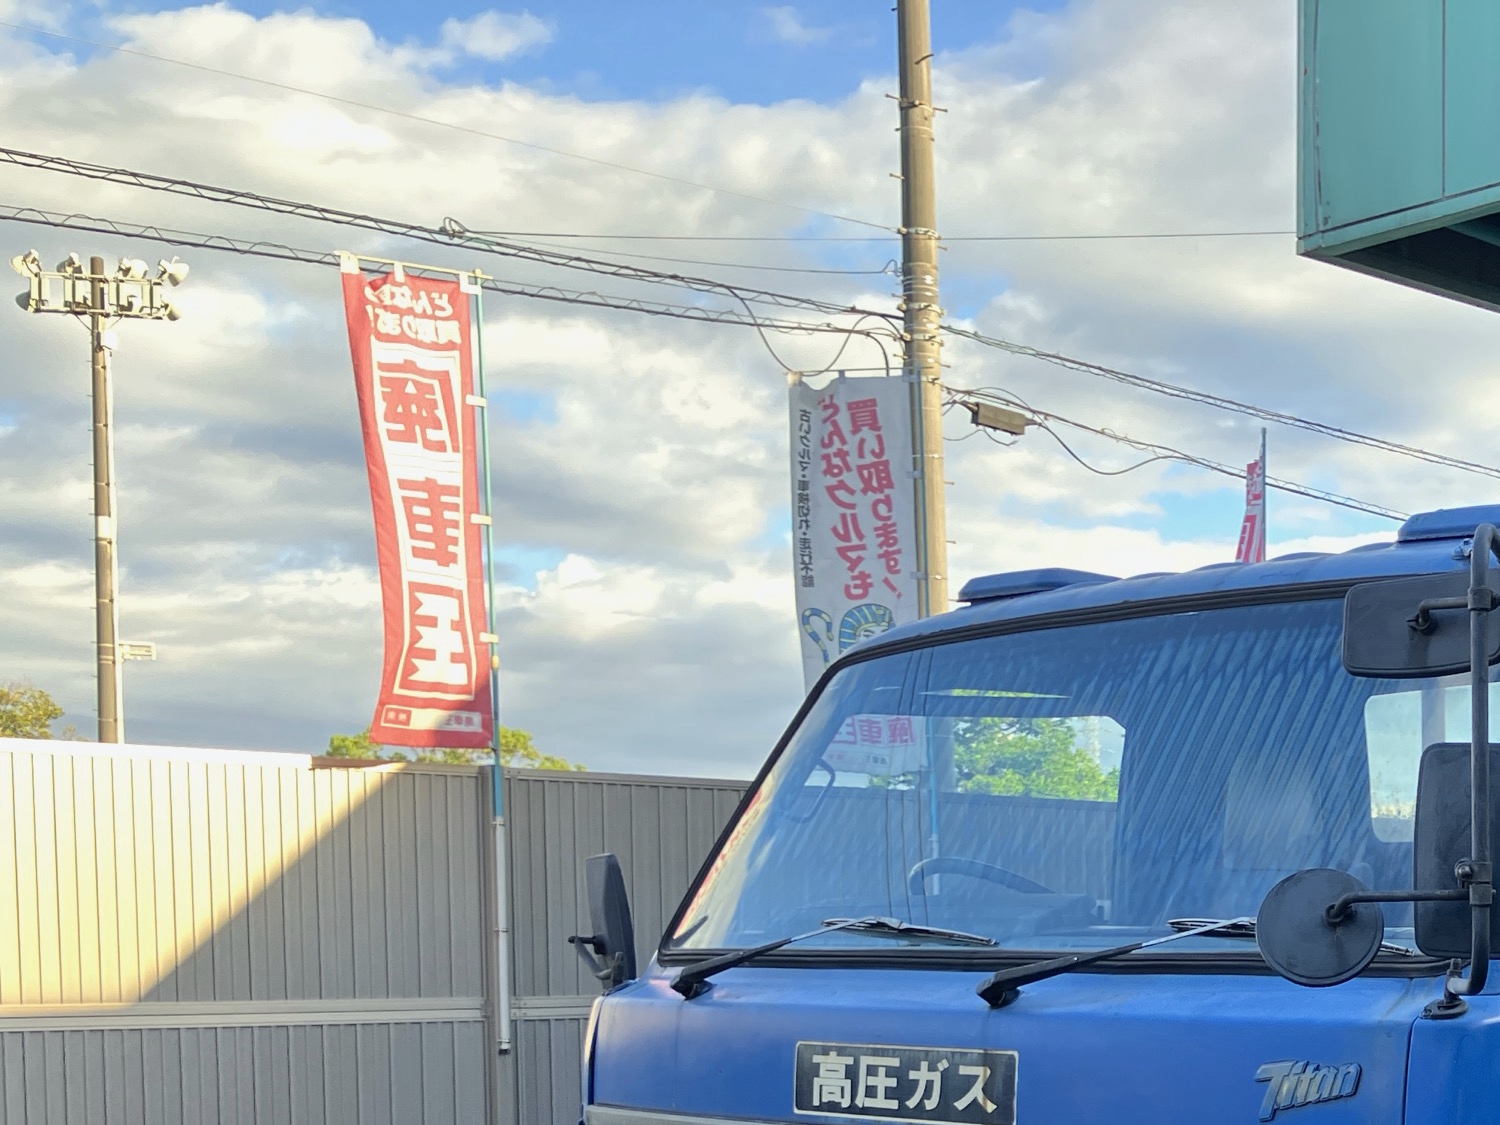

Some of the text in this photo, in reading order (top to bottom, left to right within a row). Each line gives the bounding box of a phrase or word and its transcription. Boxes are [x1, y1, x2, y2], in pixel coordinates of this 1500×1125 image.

[811, 1051, 998, 1114] 高圧ガス
[1255, 1059, 1362, 1122] Titan
